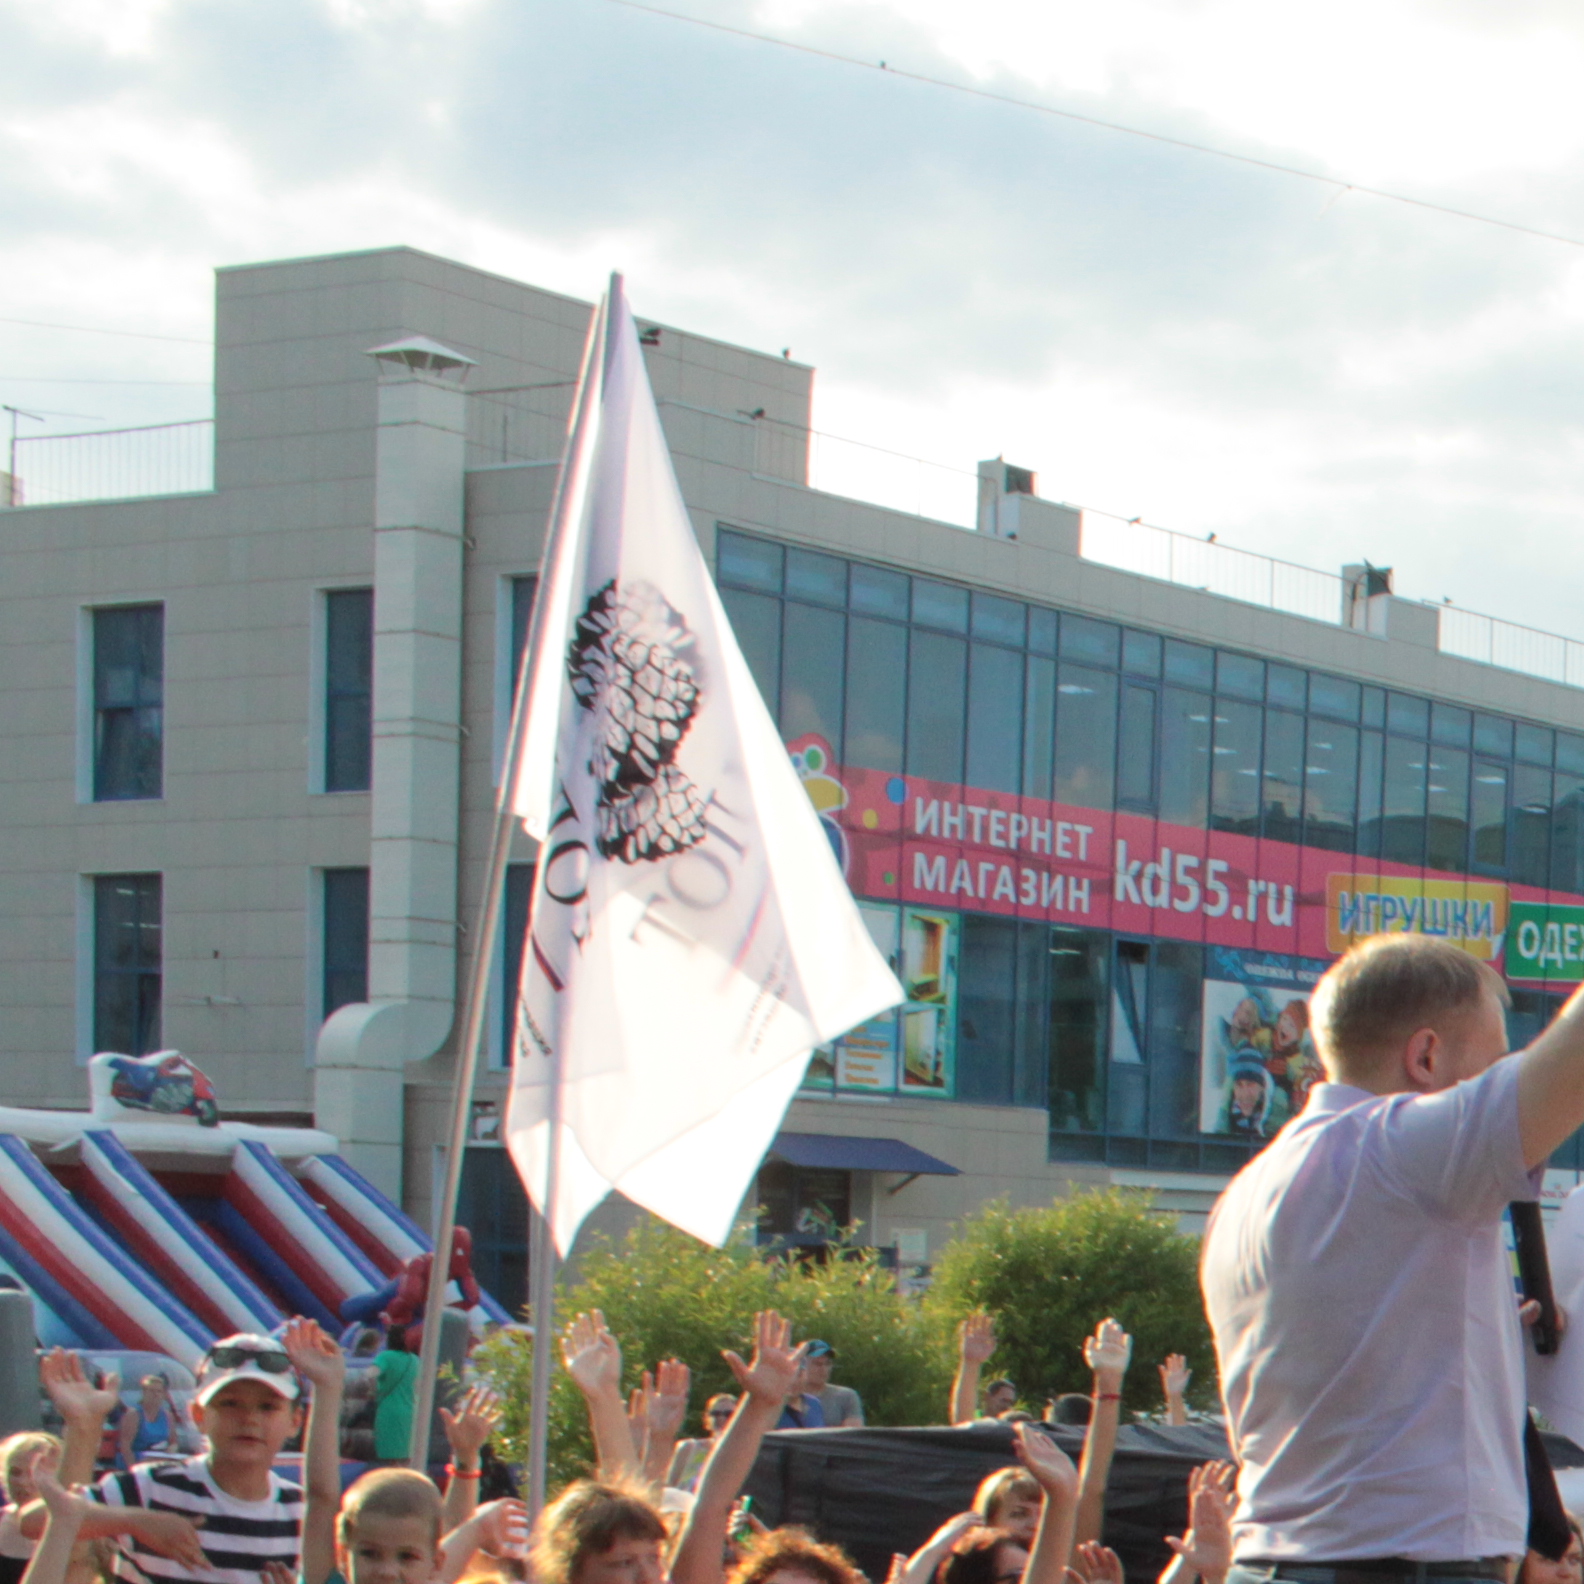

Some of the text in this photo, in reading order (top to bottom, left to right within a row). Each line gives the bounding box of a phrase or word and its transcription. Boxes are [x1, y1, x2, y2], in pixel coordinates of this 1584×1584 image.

[914, 797, 1094, 862] ИНТЕРНЕТ
[912, 851, 1090, 914] МАГАЗИН
[1114, 838, 1294, 928] kd55.ru
[1339, 891, 1494, 940] ИГРУШКИ
